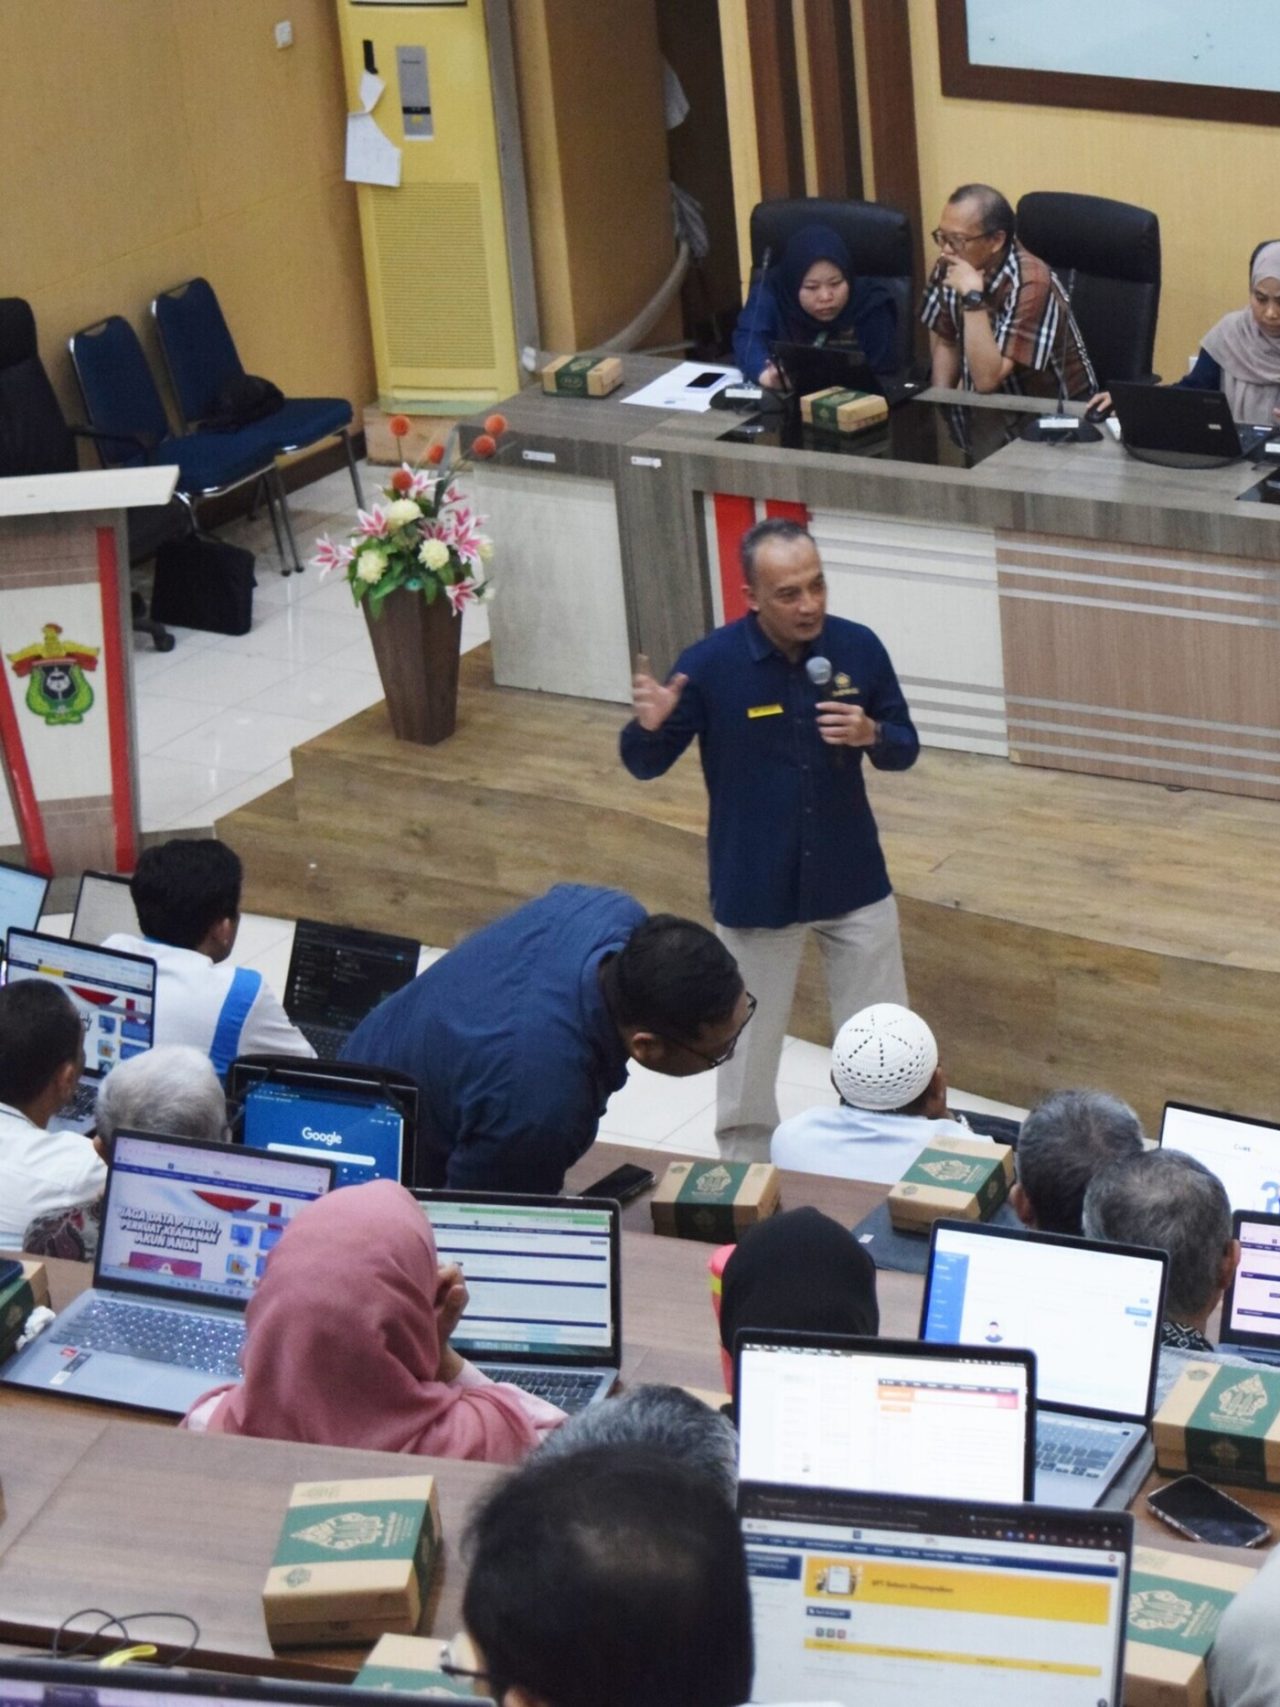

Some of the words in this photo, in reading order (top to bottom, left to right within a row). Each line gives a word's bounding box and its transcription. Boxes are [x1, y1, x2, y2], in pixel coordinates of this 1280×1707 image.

[302, 1126, 342, 1146] Google
[148, 1210, 175, 1226] DATA
[134, 1233, 167, 1247] AKUN
[167, 1237, 199, 1253] ANDA
